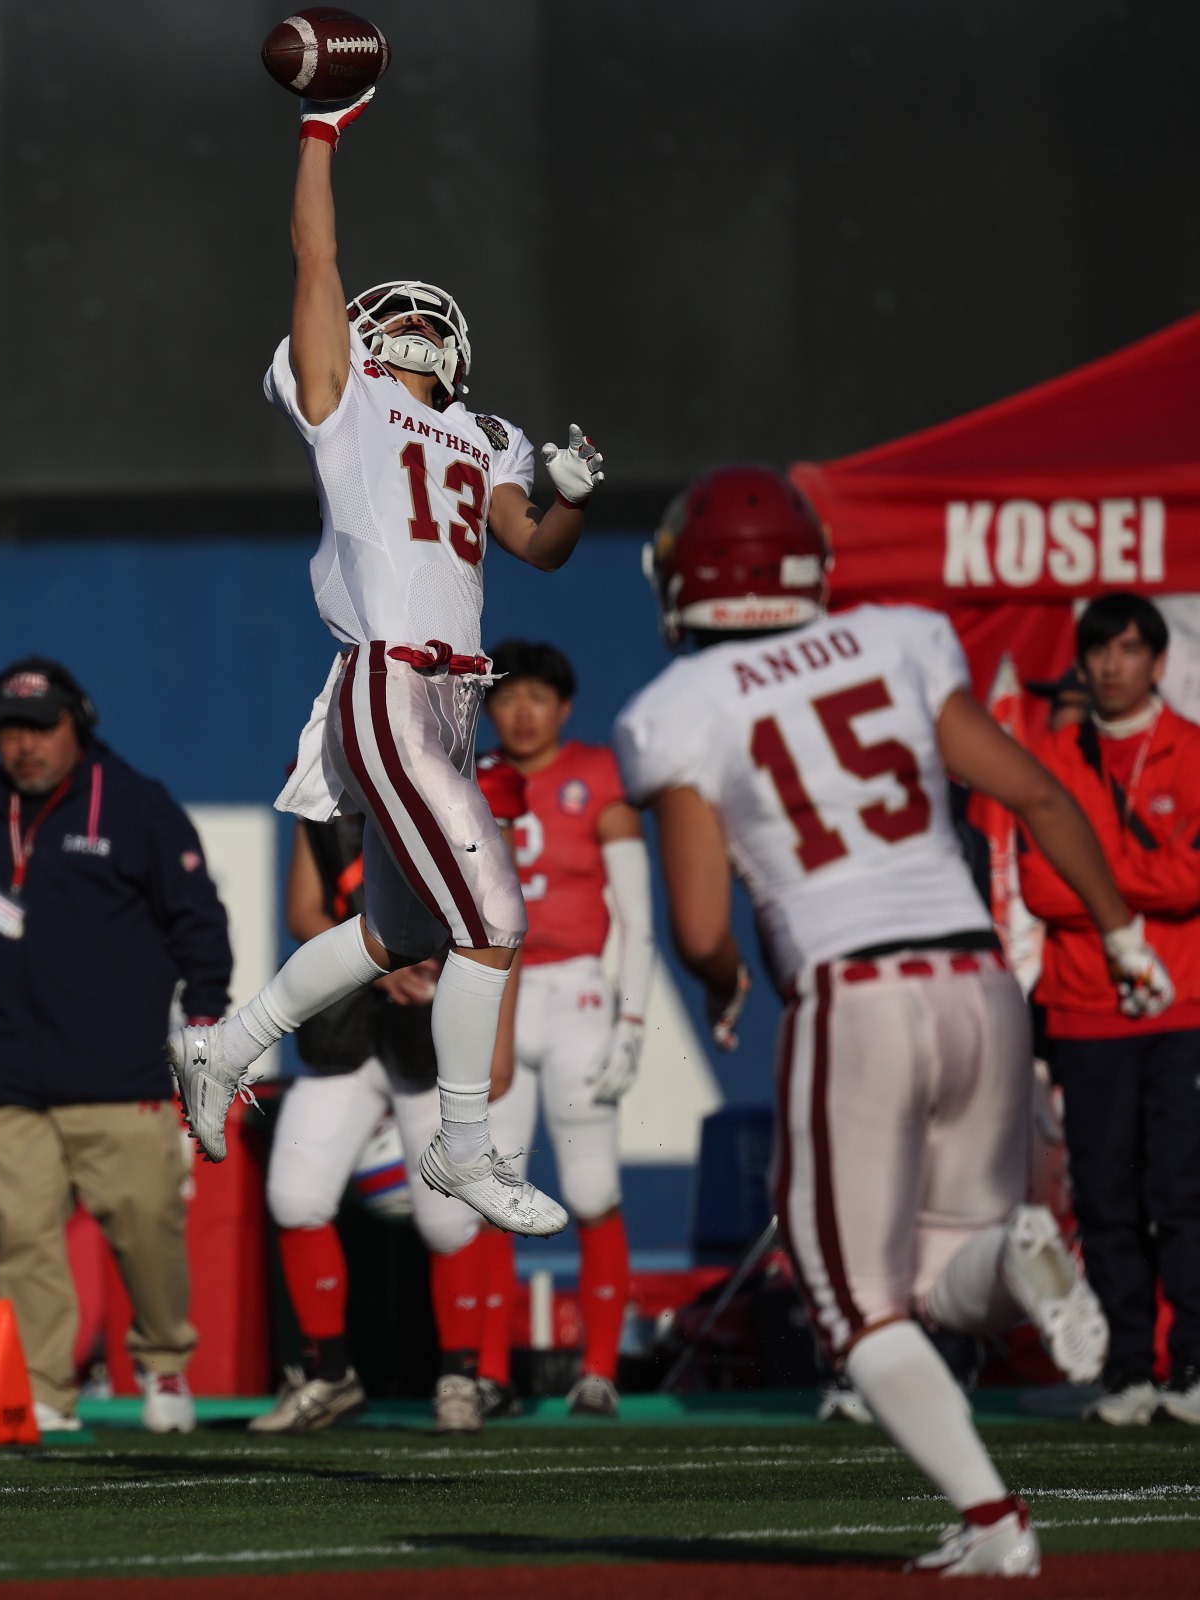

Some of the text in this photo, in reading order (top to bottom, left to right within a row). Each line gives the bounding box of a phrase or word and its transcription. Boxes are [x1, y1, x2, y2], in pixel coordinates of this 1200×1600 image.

[389, 409, 490, 472] PANTHERS
[399, 440, 487, 568] 13
[944, 496, 1165, 588] KOSEI
[733, 629, 861, 694] ANDO
[749, 673, 933, 877] 15
